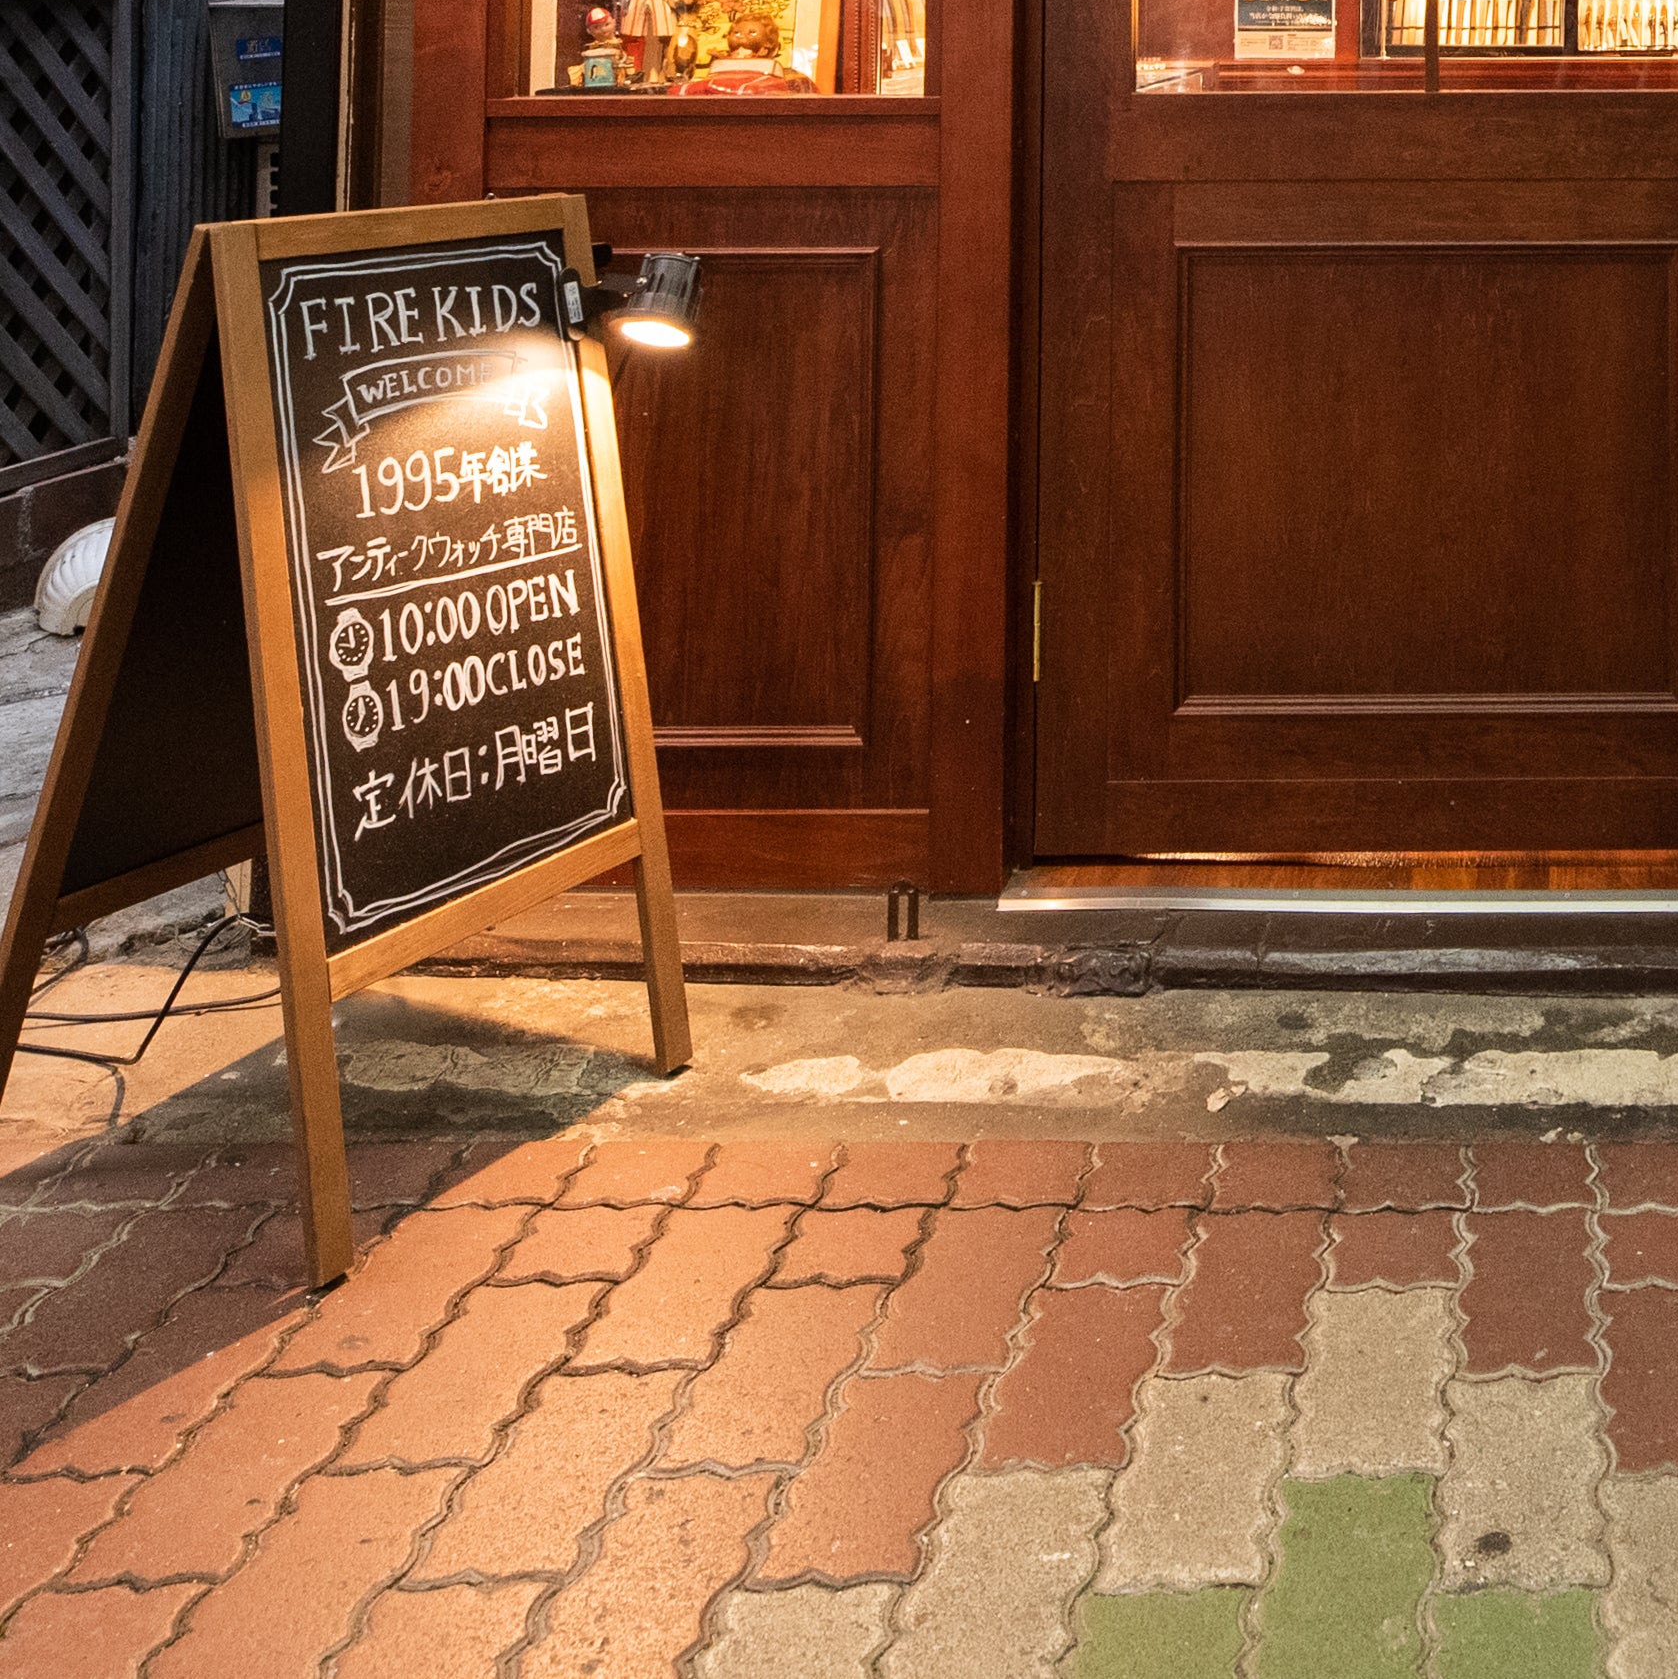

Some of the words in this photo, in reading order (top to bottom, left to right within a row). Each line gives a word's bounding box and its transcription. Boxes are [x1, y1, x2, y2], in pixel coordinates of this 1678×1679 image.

[299, 286, 424, 360] FIRE
[432, 282, 541, 342] KIDS
[356, 361, 493, 404] WELCOME
[351, 441, 549, 519] 1995年創業
[378, 591, 481, 663] 10:00
[485, 568, 581, 635] OPEN
[386, 655, 487, 731] 19:00
[485, 632, 586, 696] CLOSE
